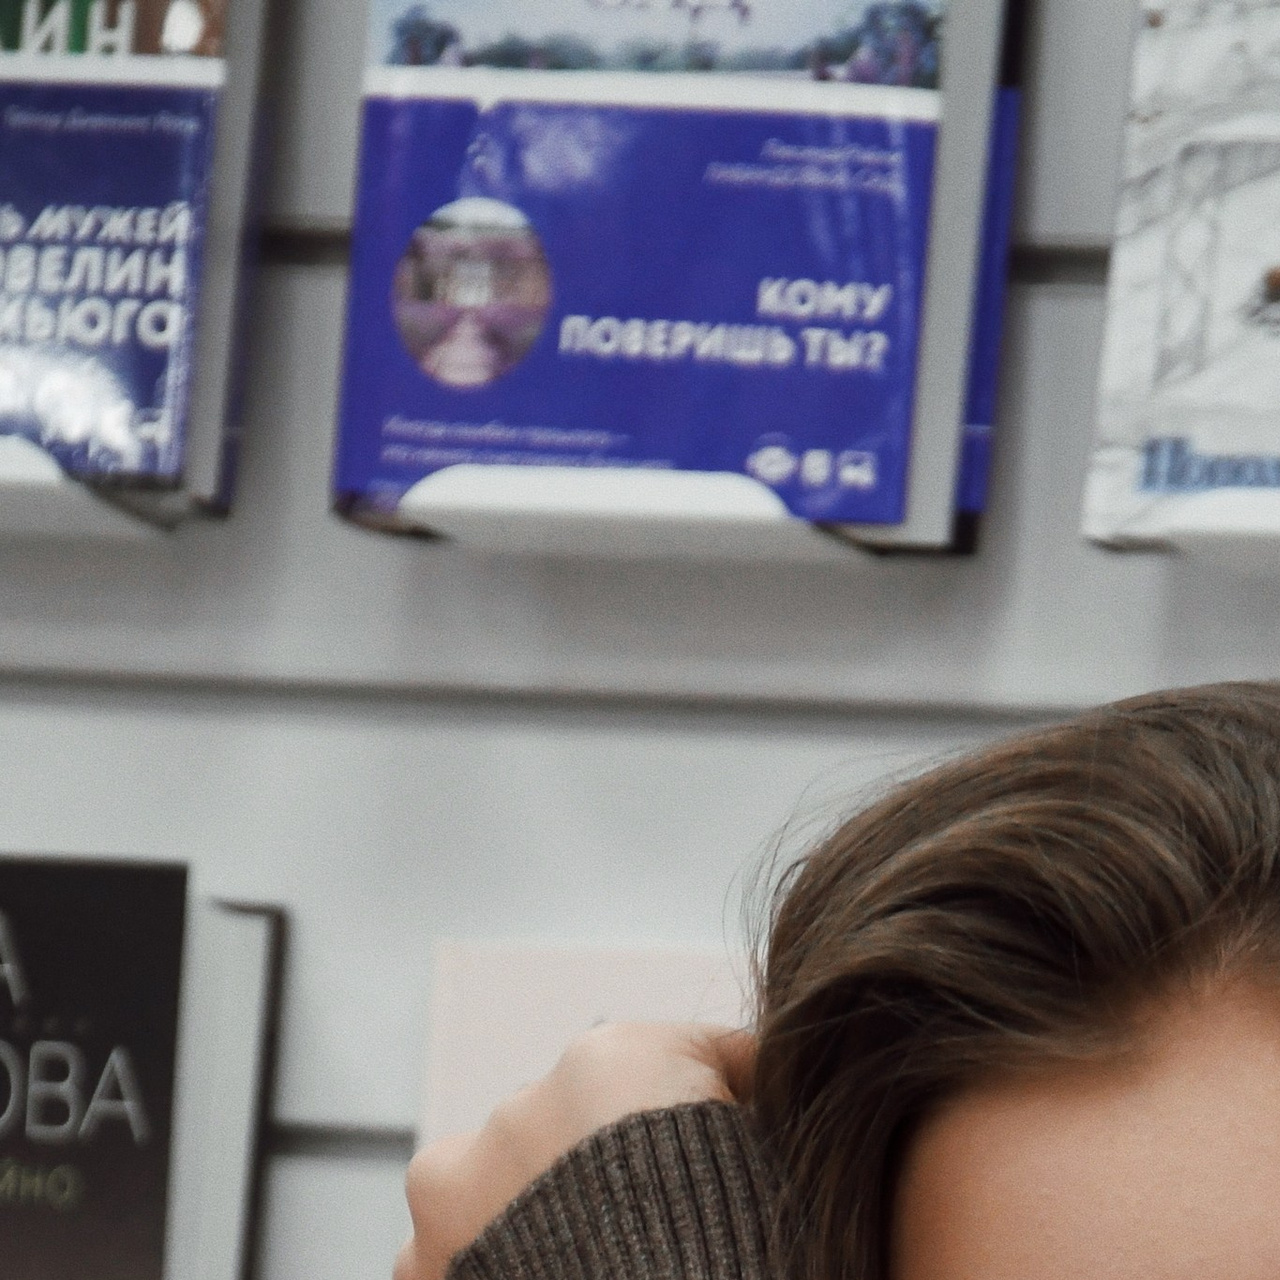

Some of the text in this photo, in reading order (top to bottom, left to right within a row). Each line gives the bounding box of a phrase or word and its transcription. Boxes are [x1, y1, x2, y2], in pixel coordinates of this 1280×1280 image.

[26, 201, 191, 243] МУЖЕЙ
[0, 244, 189, 299] ВЕЛИН
[757, 277, 892, 321] КОМУ
[558, 314, 889, 373] ПОВЕРИШЬ ТЫ?
